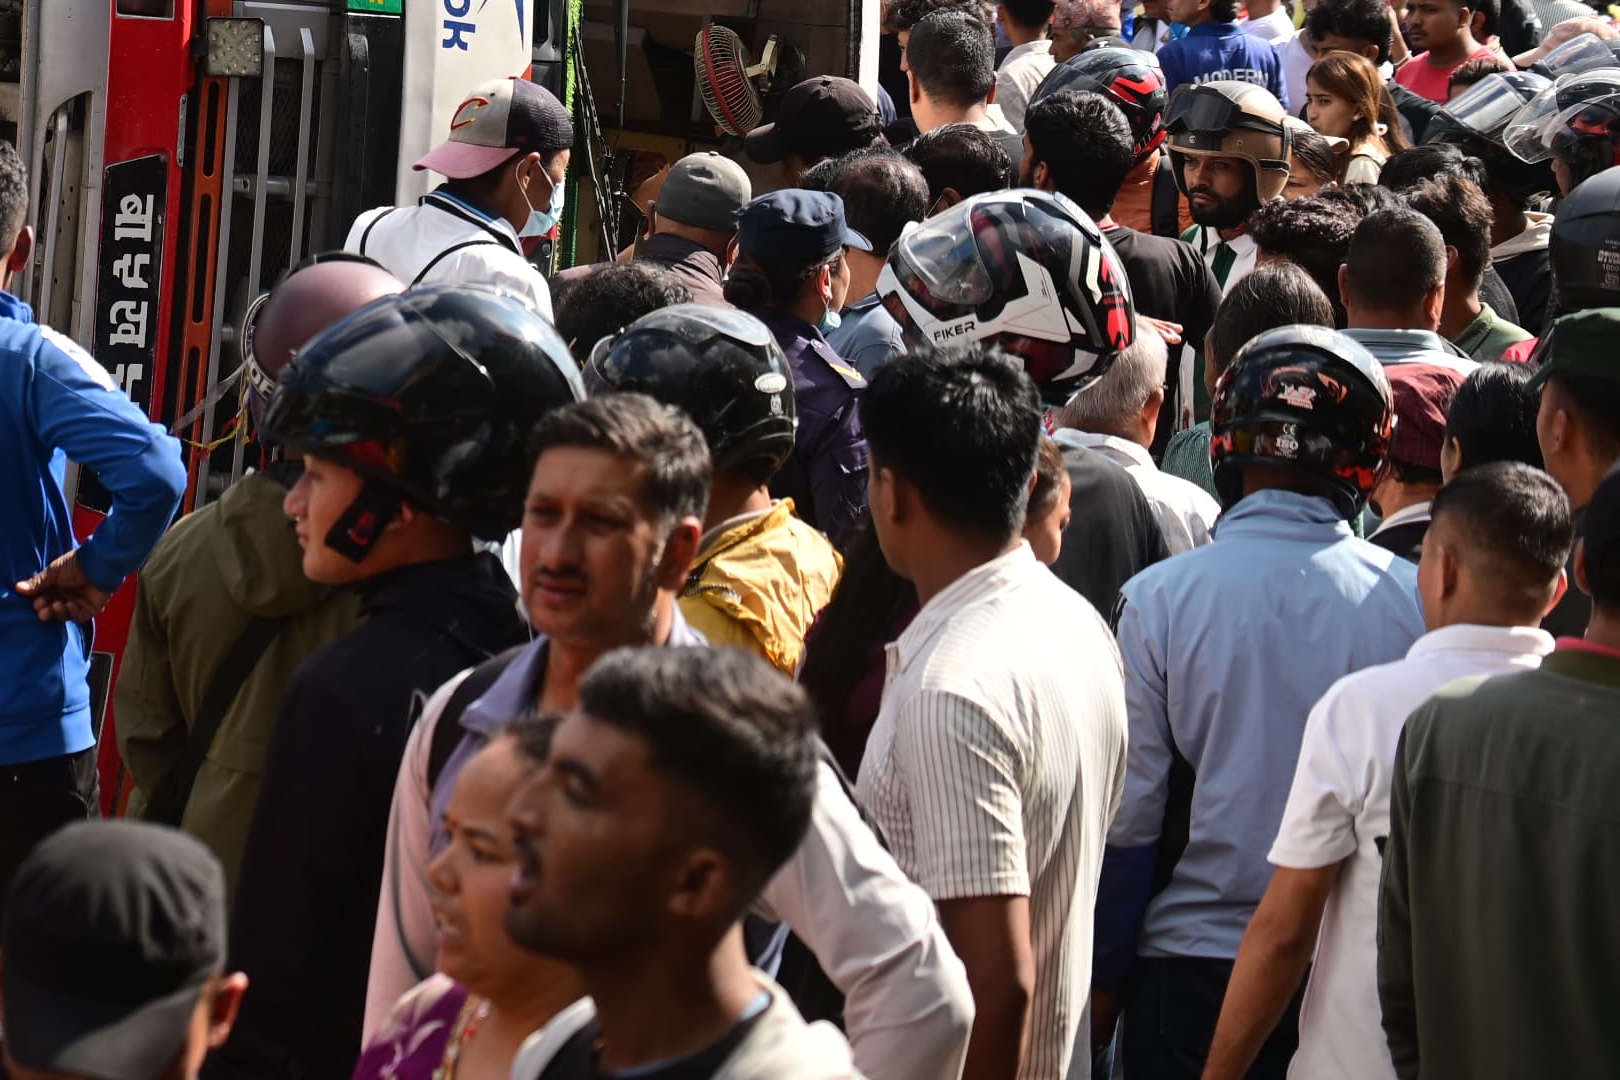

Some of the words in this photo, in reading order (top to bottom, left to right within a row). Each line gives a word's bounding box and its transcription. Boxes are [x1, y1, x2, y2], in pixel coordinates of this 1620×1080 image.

[113, 193, 155, 243] बा
[111, 253, 152, 290] ५
[108, 300, 150, 349] ख
[933, 320, 976, 343] FIKER
